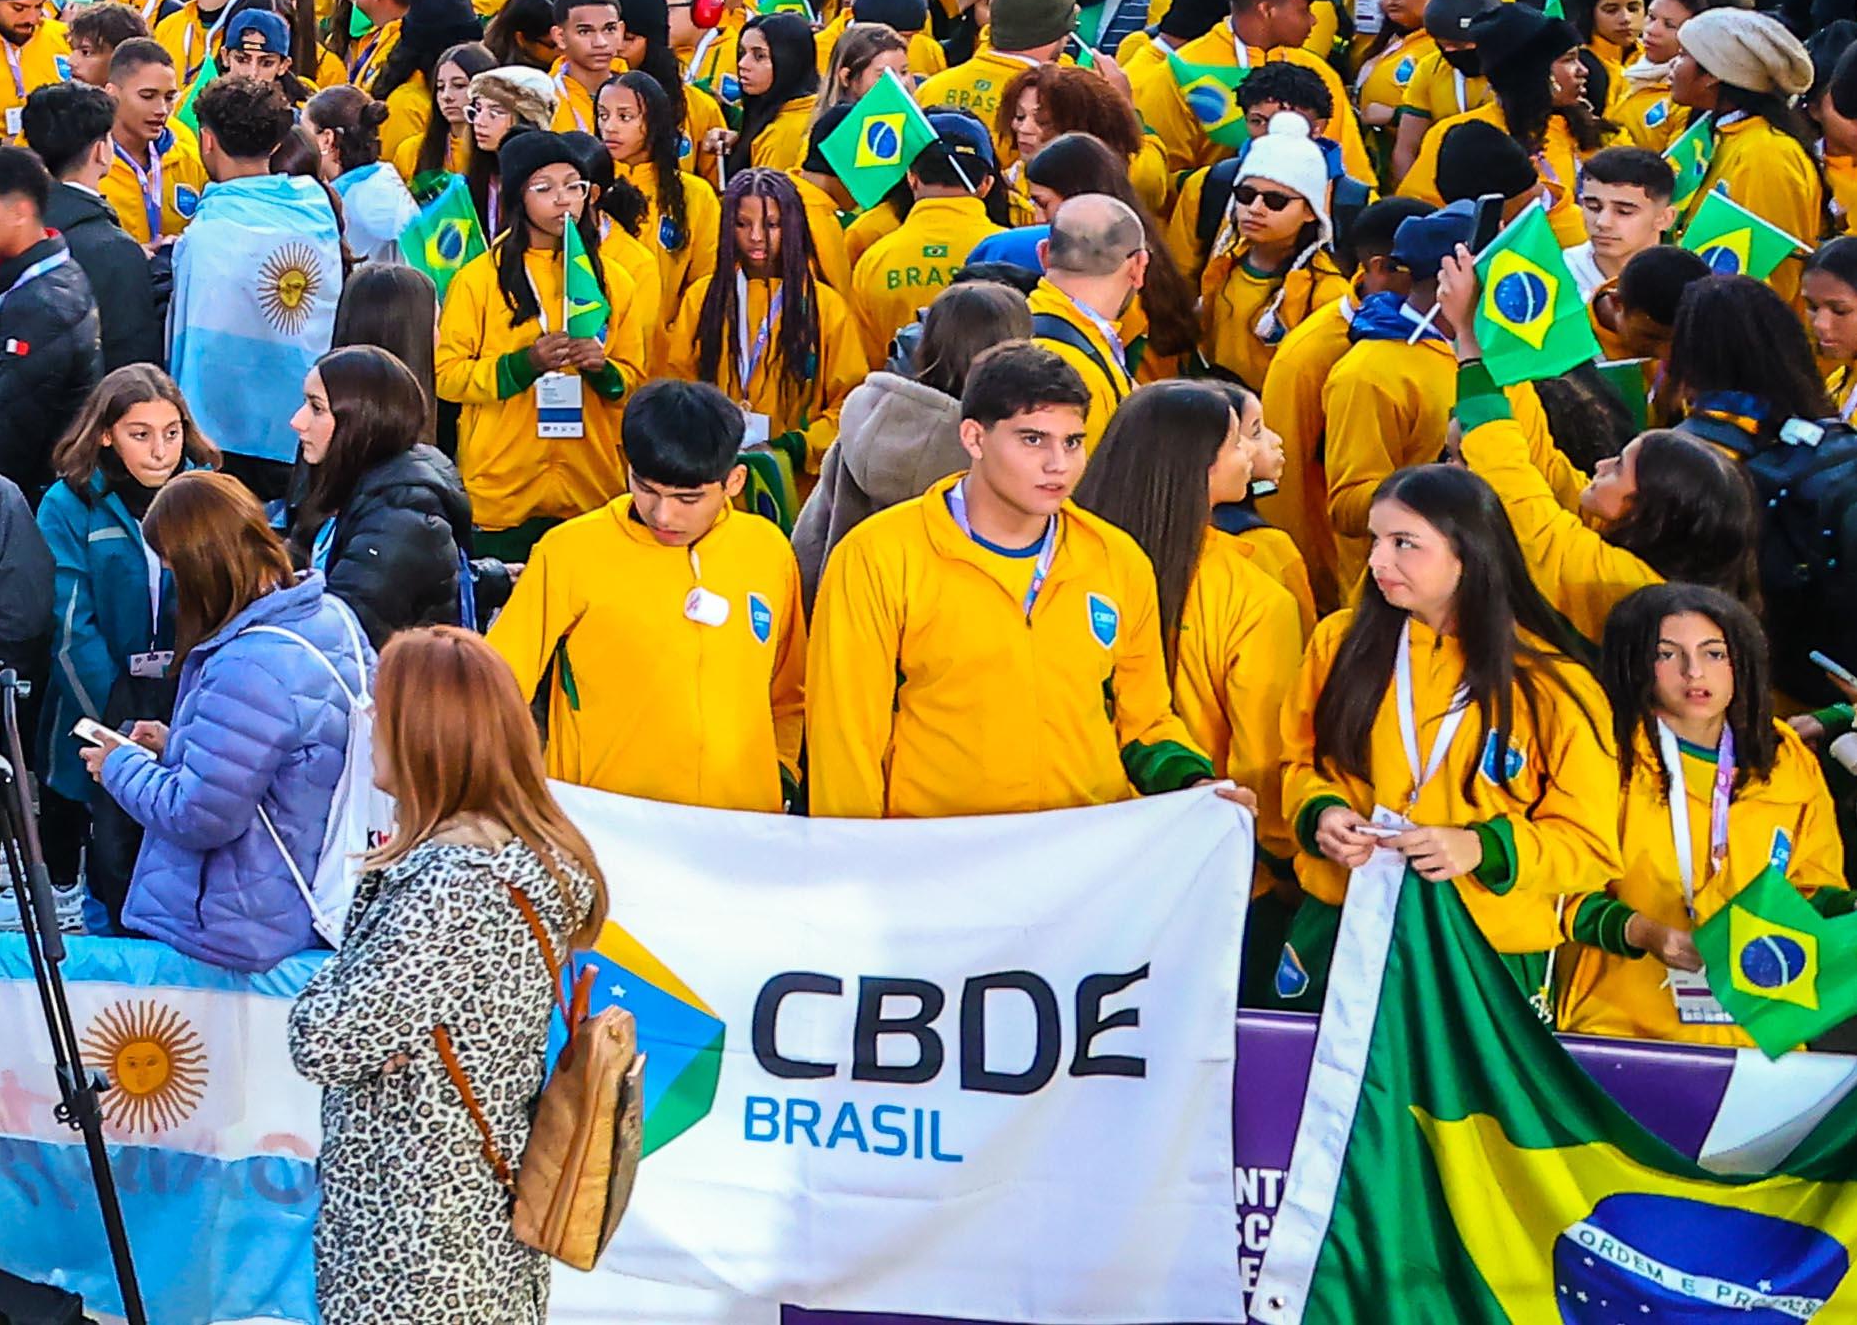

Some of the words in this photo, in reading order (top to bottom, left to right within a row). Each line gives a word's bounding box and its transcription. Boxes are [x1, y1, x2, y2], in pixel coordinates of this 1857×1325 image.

[944, 88, 997, 113] BRAS
[751, 961, 1151, 1096] CBDE
[743, 1095, 964, 1163] BRASIL
[1681, 1277, 1696, 1294] E
